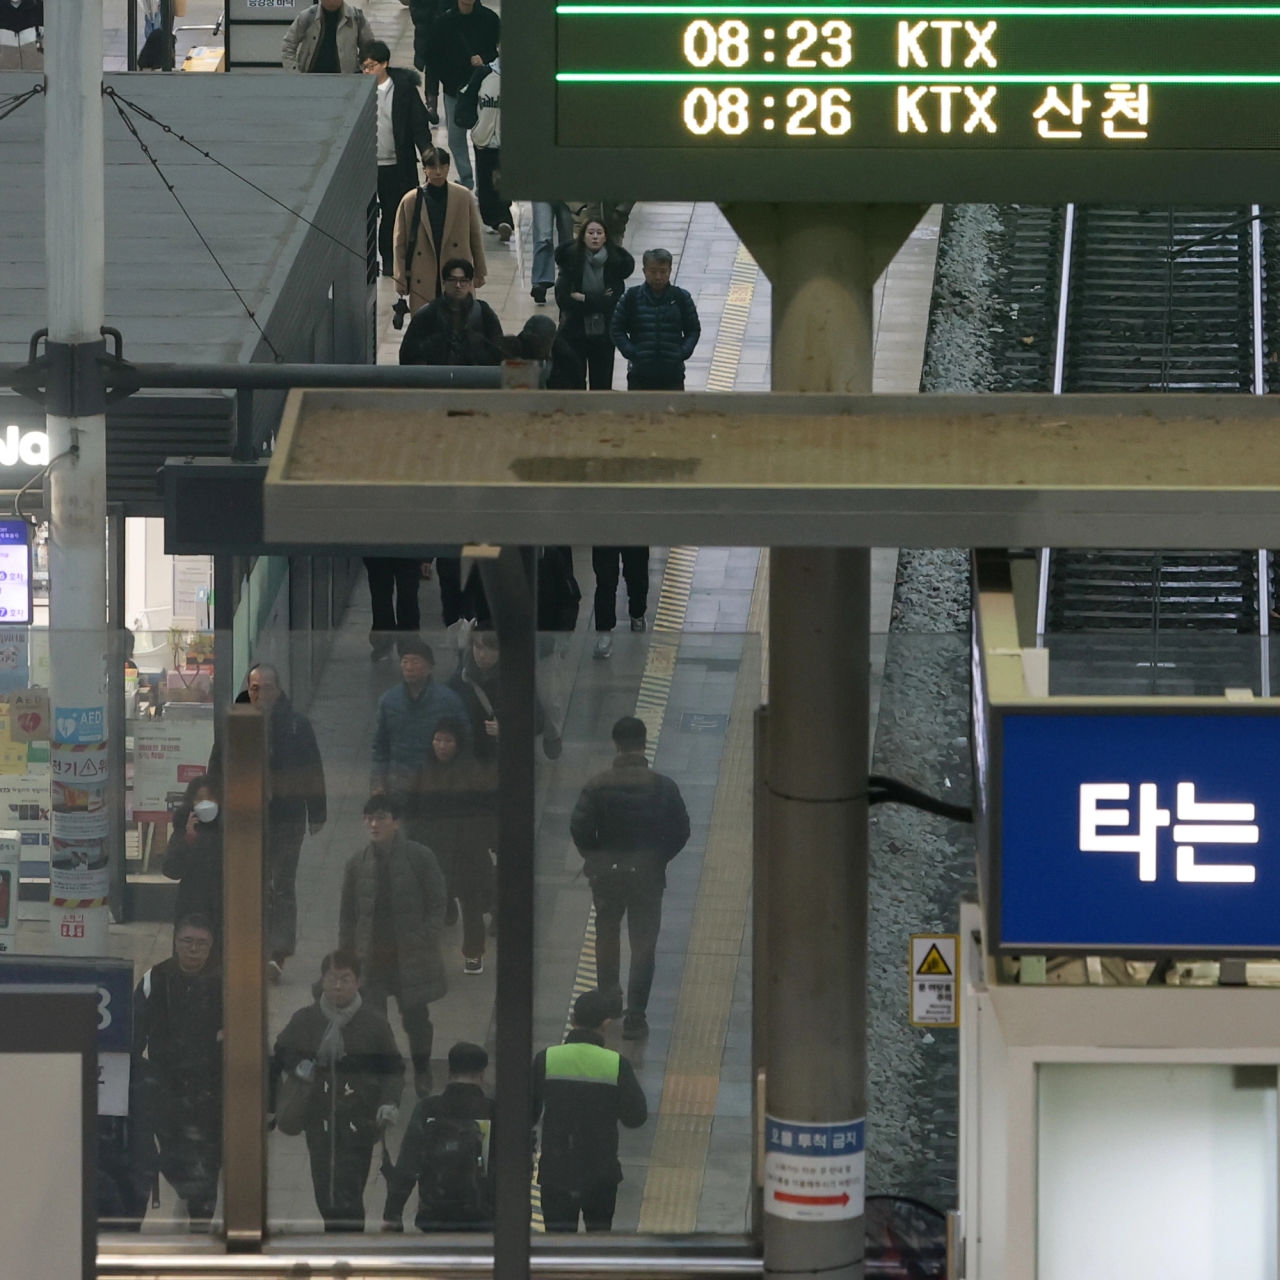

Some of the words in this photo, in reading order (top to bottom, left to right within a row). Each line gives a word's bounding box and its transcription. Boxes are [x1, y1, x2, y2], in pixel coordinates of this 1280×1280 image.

[683, 20, 852, 68] 08:23
[897, 20, 997, 68] KTX
[683, 87, 851, 135] 08:26
[897, 85, 997, 133] KTX
[1030, 81, 1153, 139] 산천
[9, 573, 23, 581] 호차
[10, 609, 23, 617] 호차
[80, 711, 102, 724] AED
[52, 759, 77, 777] 전기
[1079, 782, 1258, 883] 타는
[771, 1128, 792, 1147] 오물
[798, 1133, 826, 1149] 투척
[833, 1131, 856, 1149] 금지
